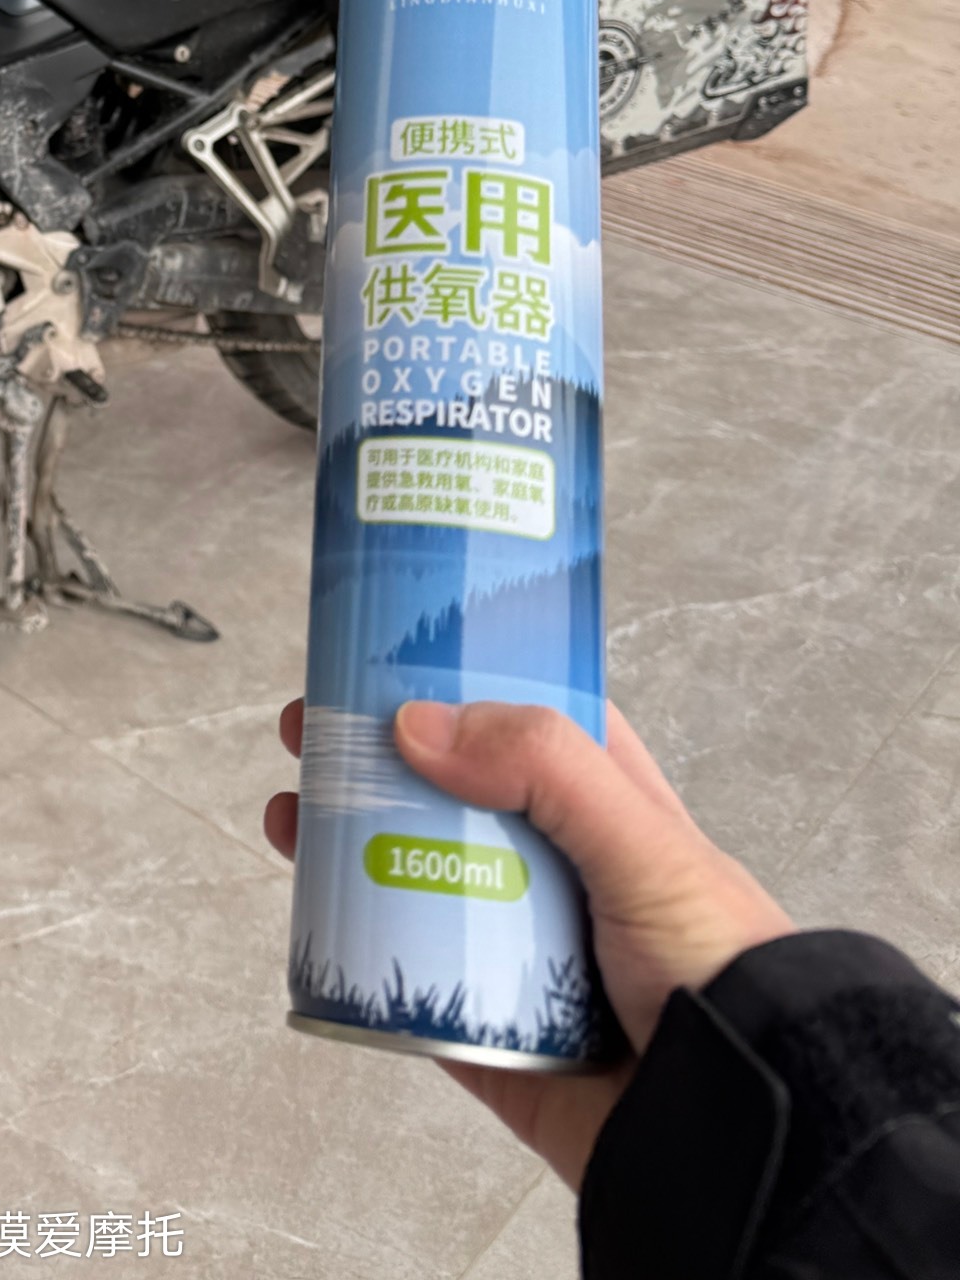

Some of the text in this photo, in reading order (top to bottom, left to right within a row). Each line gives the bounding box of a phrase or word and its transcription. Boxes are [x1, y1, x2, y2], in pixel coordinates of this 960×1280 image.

[400, 121, 517, 160] 便携式
[365, 170, 552, 265] 医用
[362, 263, 552, 339] 供氧器
[363, 335, 552, 376] PORTABLE
[361, 367, 552, 411] OXYGEN
[361, 399, 553, 443] RESPIRATOR
[388, 846, 504, 890] 1600ml
